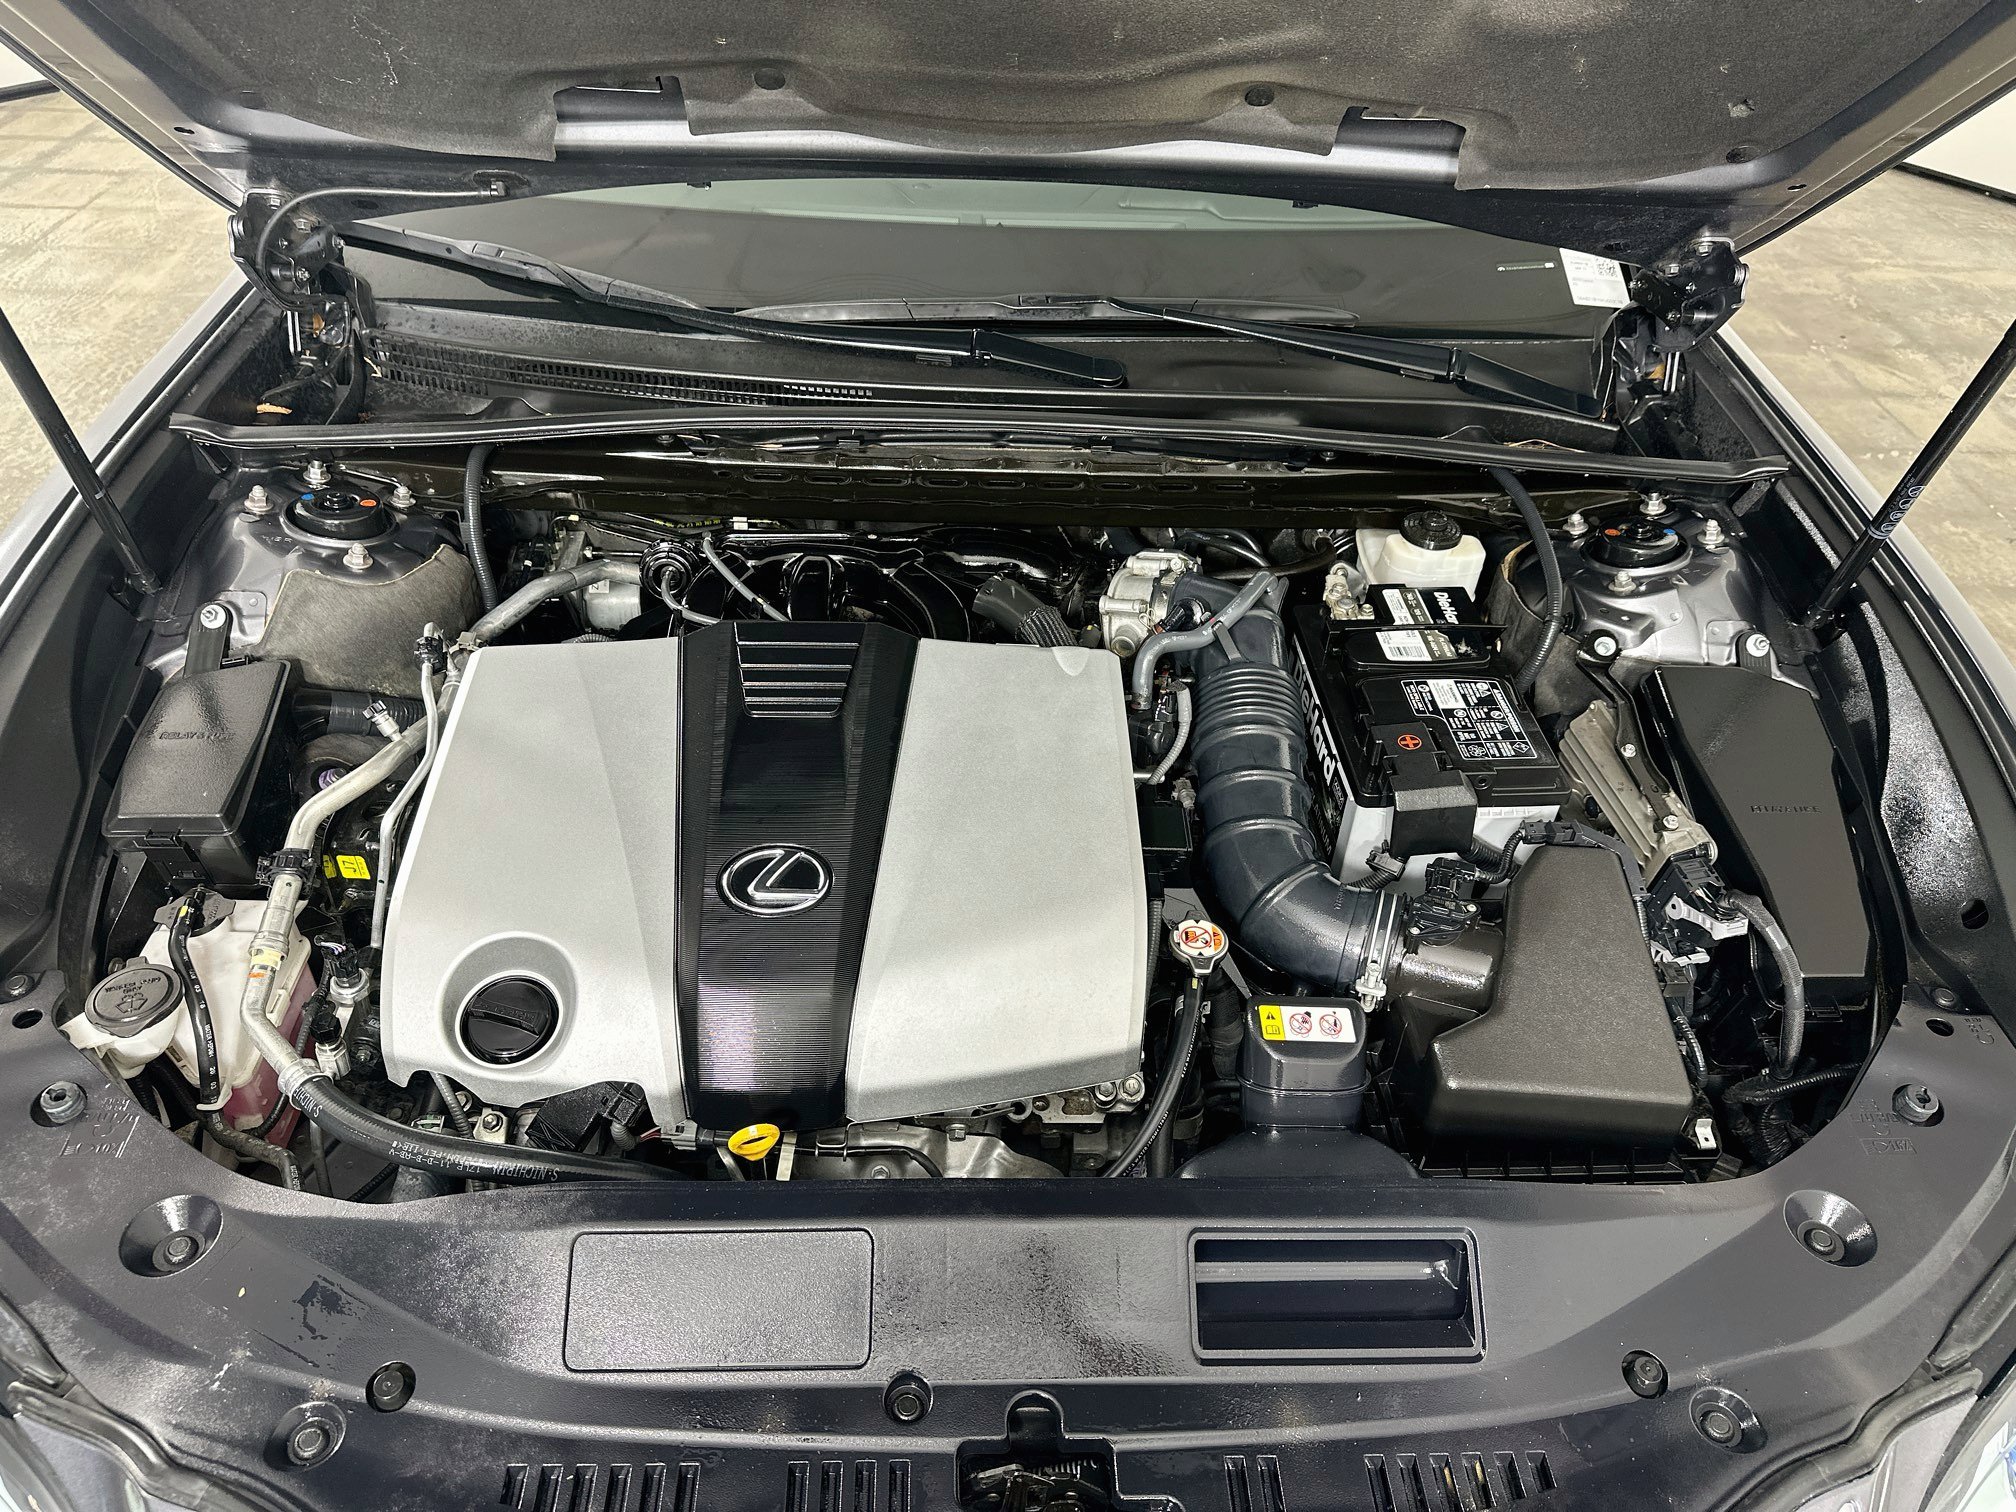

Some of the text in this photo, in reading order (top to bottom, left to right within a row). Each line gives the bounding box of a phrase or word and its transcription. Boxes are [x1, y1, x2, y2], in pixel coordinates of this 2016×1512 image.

[1433, 591, 1460, 624] DieHar
[159, 731, 197, 739] RELAY
[1293, 661, 1335, 786] DieHard
